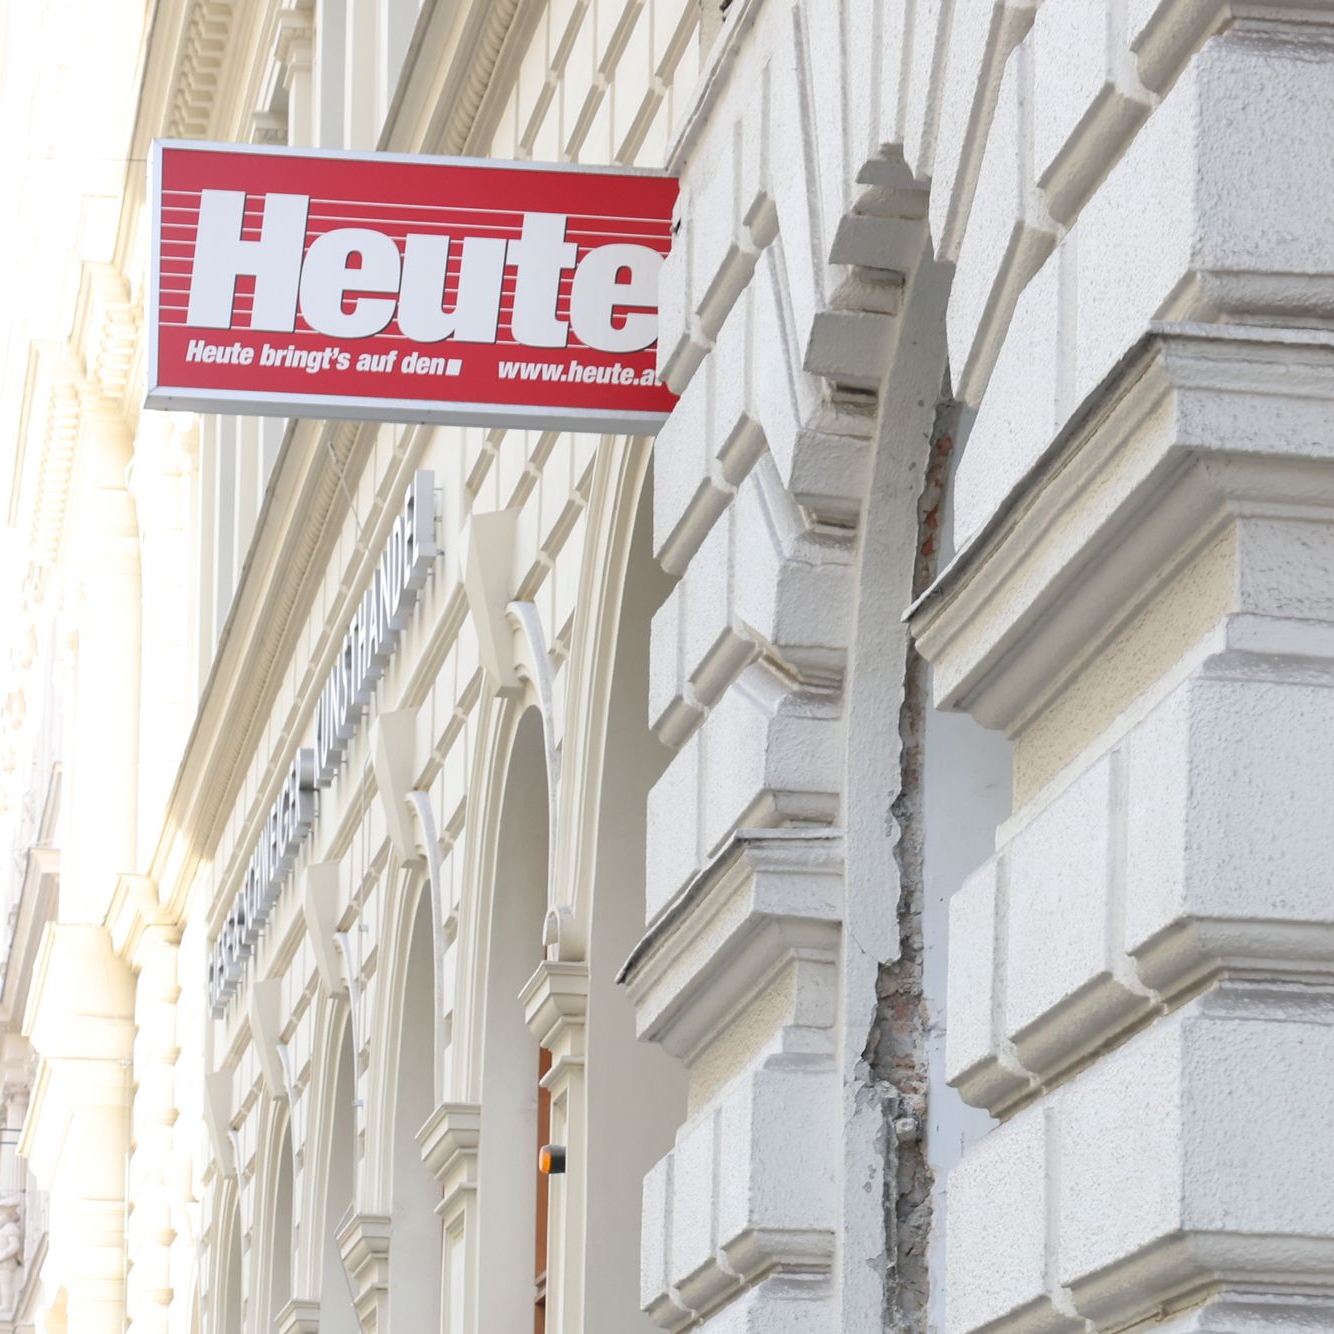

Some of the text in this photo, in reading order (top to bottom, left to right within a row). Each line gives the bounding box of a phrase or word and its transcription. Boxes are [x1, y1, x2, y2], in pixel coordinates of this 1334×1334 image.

[186, 188, 665, 353] Heute
[185, 339, 255, 365] Heute
[259, 343, 351, 374] bringt's
[356, 350, 399, 374] auf
